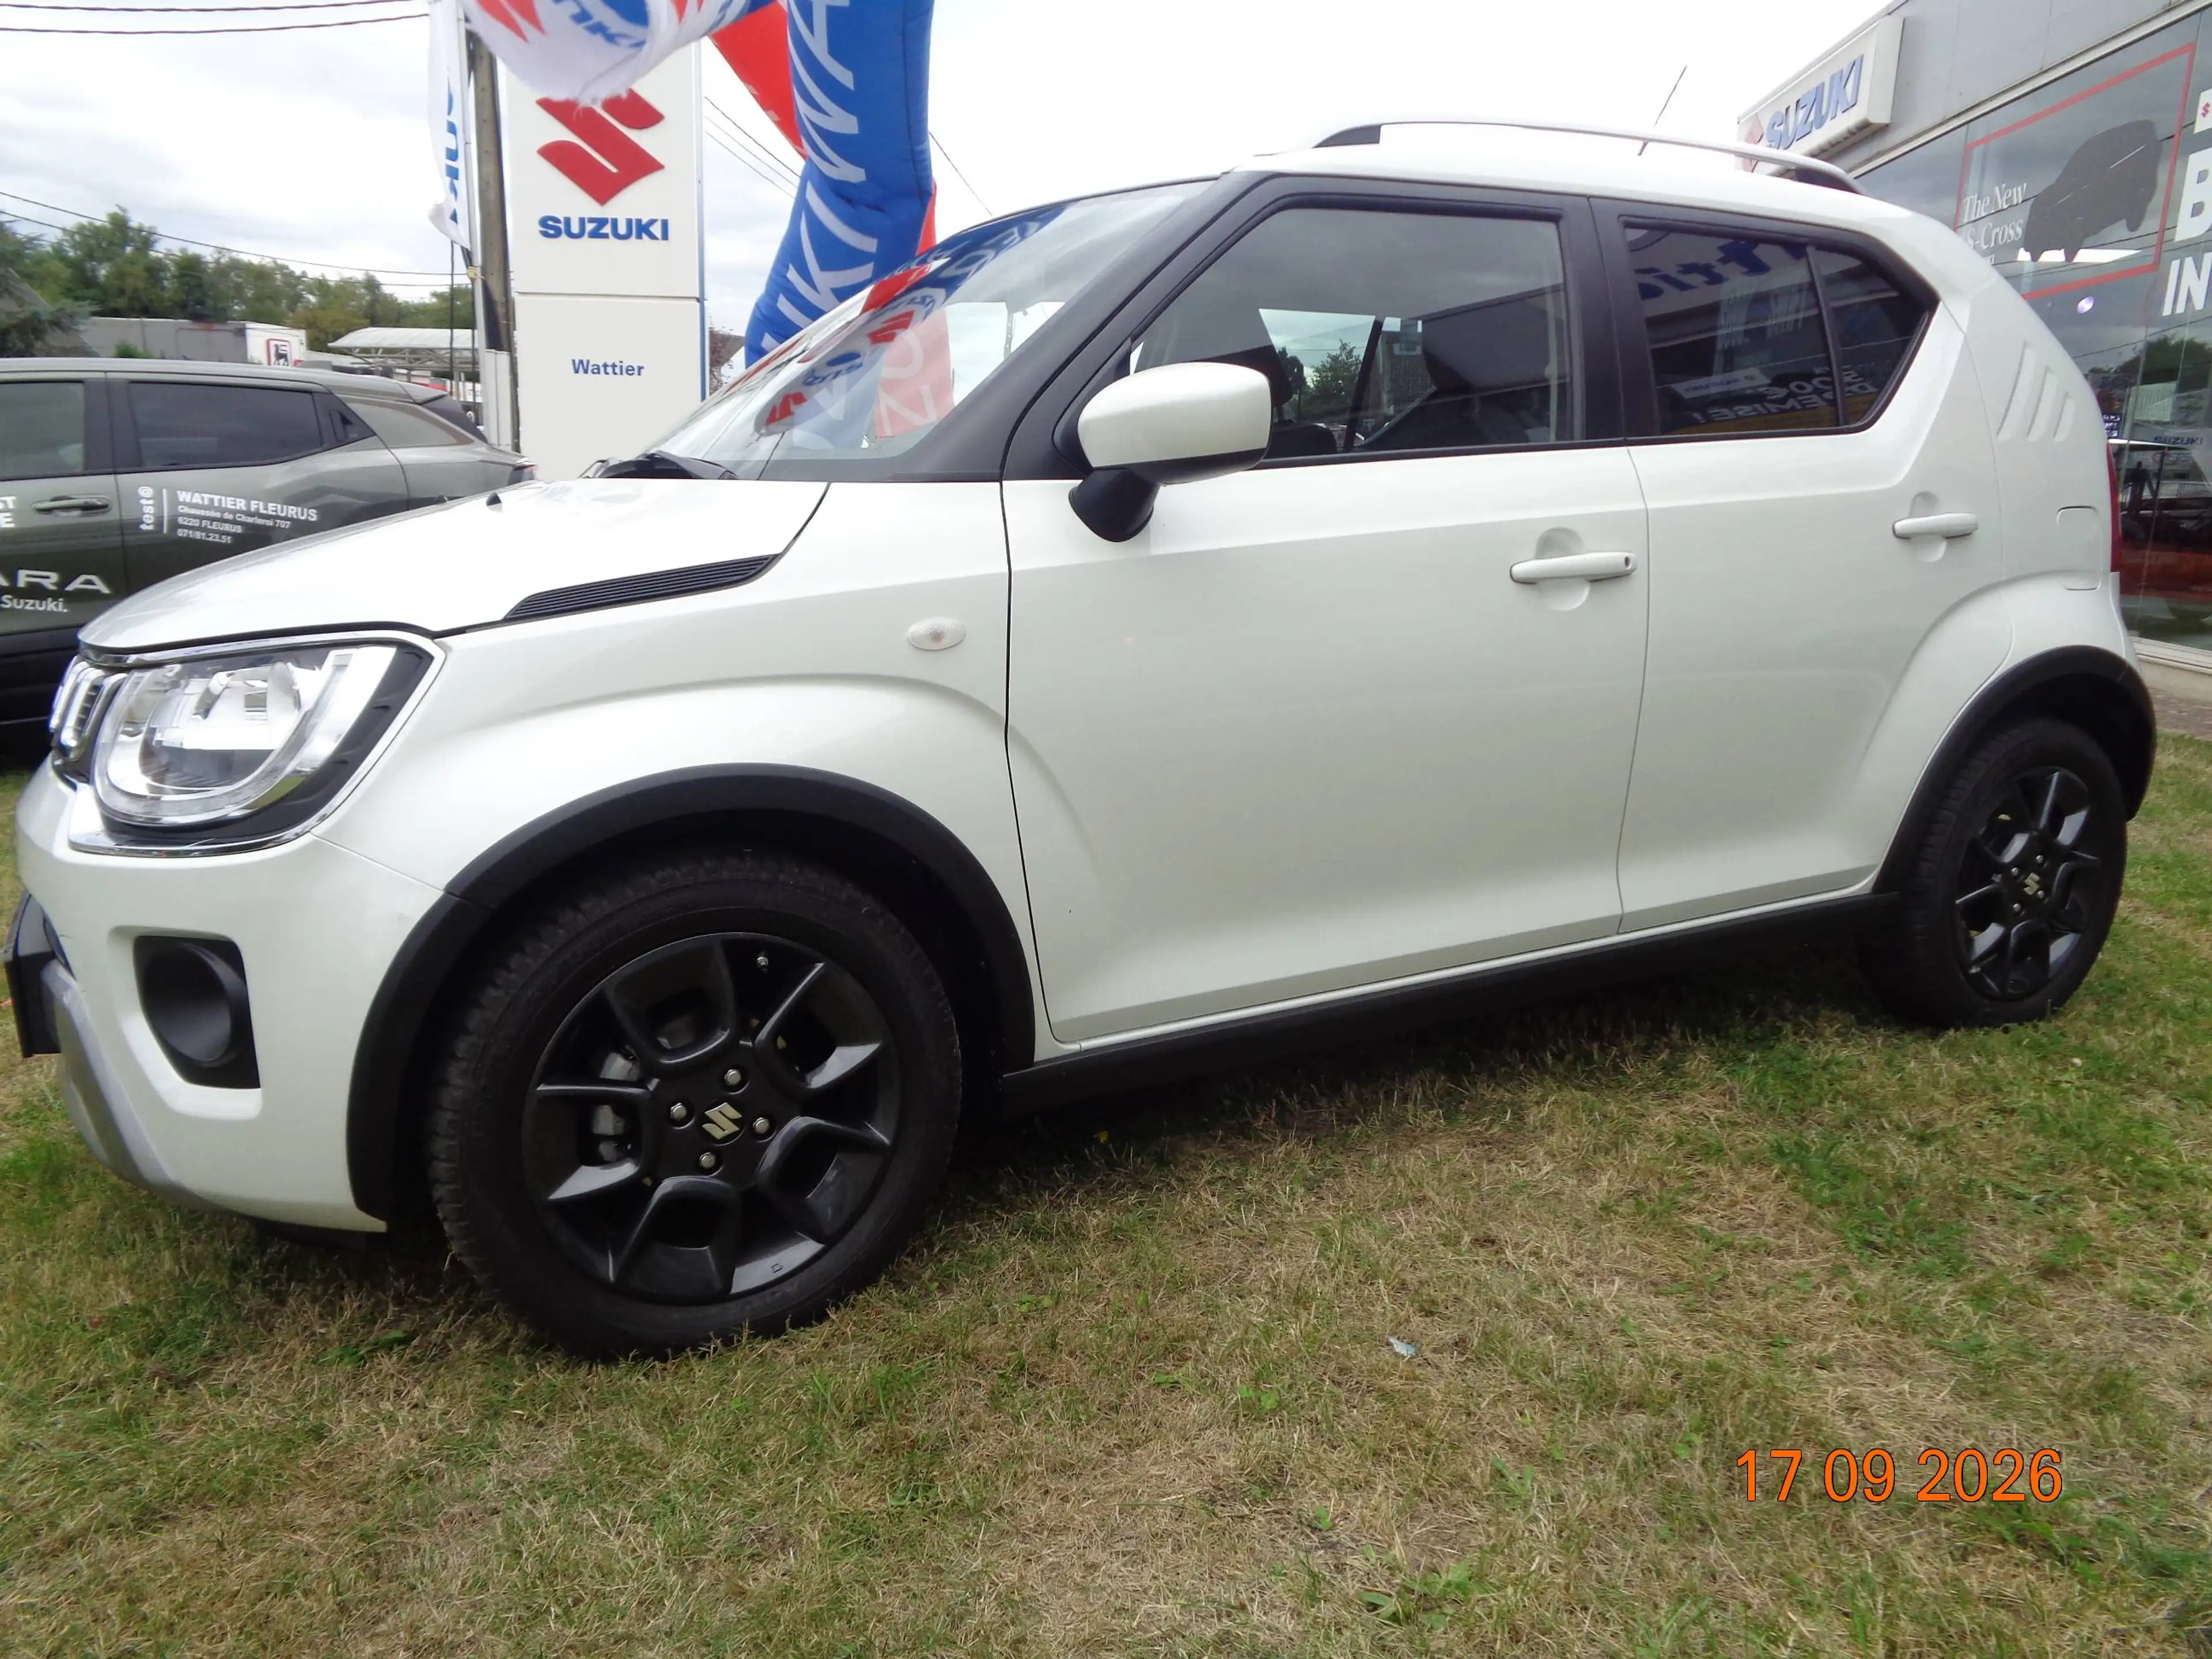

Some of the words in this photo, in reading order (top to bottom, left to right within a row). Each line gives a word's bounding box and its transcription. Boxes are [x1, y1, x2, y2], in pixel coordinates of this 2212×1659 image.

[1766, 54, 1864, 151] SUZUKI
[1963, 193, 1990, 223] The
[1991, 183, 2028, 213] New
[538, 215, 669, 241] SUZUKI
[1967, 220, 2024, 249] S-Cross
[571, 358, 645, 376] Wattier
[176, 490, 247, 511] WATTIER
[250, 500, 318, 521] FLEURUS
[222, 512, 233, 520] de
[177, 517, 200, 527] 6220
[201, 520, 243, 533] FLEURUS
[1, 594, 68, 612] Suzuki.
